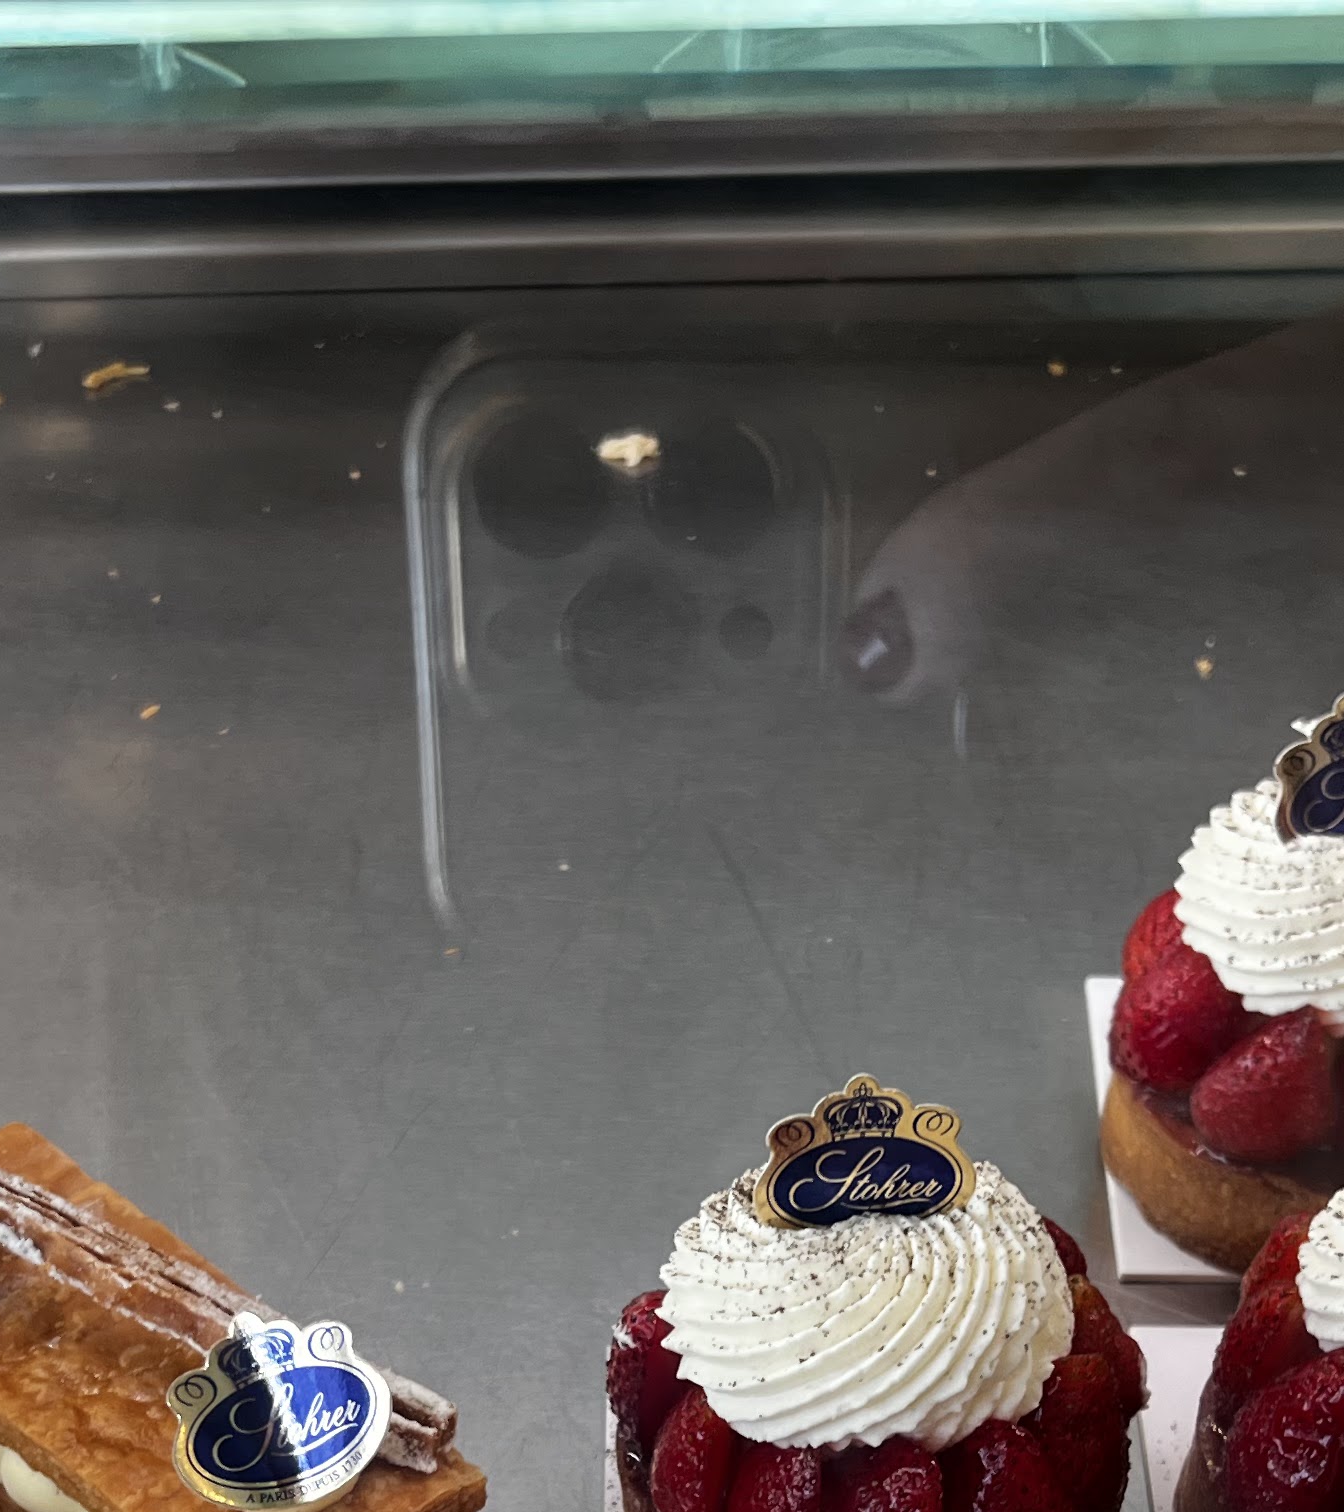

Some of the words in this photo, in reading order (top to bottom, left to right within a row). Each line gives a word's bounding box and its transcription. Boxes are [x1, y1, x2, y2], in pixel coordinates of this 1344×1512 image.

[788, 1146, 943, 1213] Stohrer
[260, 1488, 296, 1504] PARIS
[343, 1451, 364, 1475] 1730
